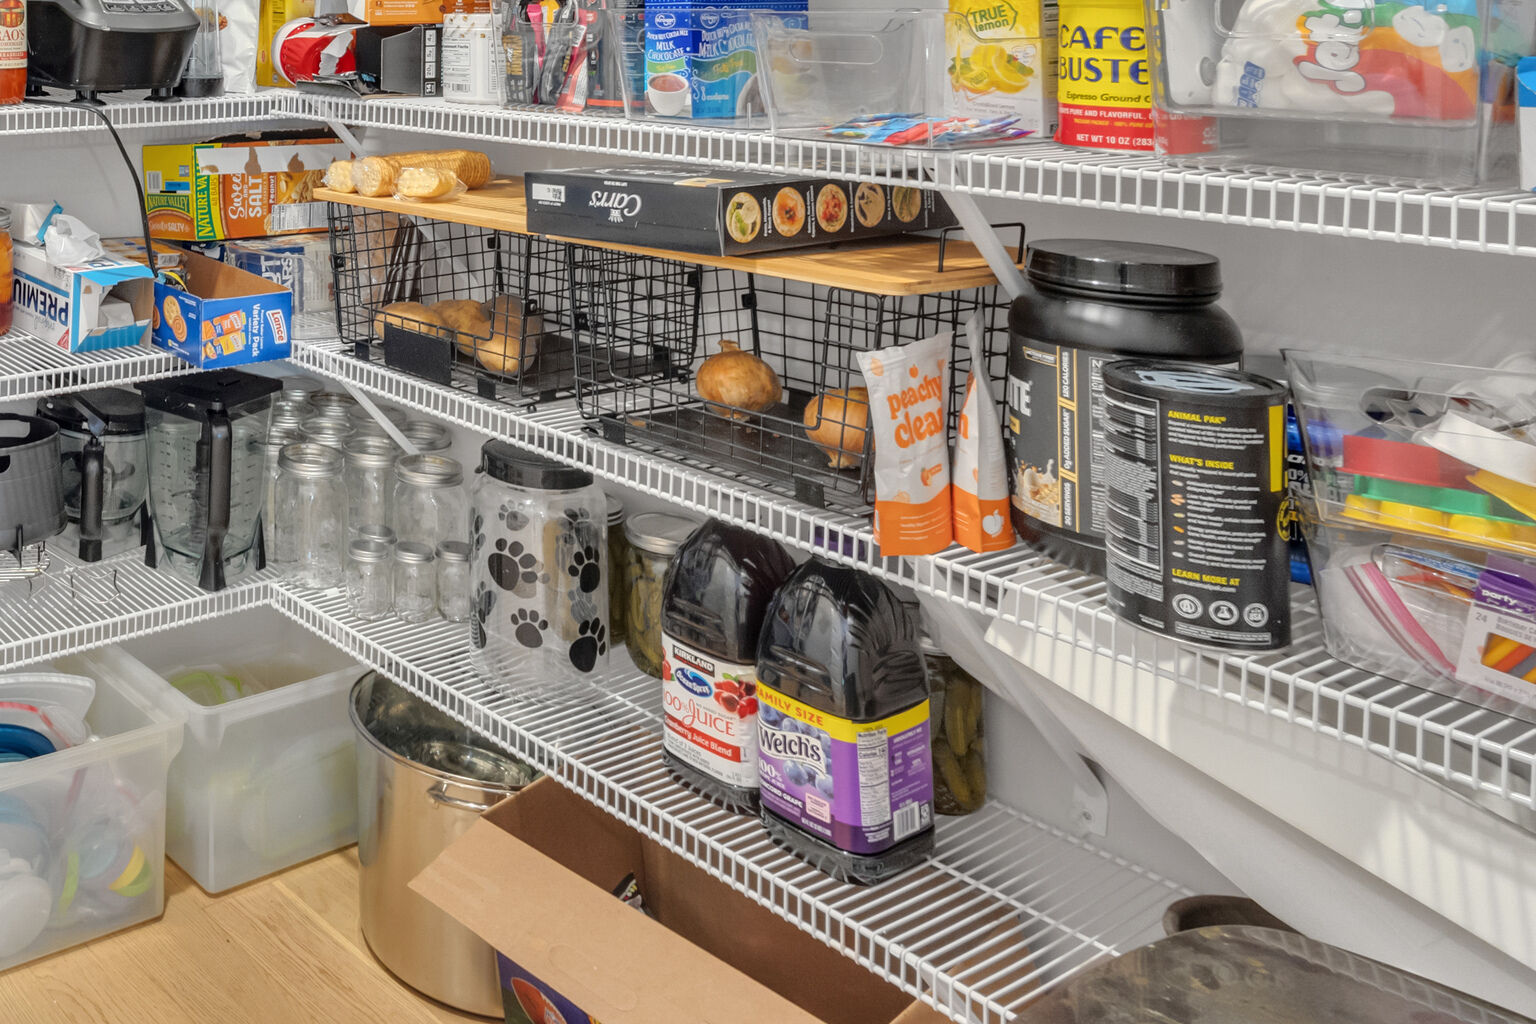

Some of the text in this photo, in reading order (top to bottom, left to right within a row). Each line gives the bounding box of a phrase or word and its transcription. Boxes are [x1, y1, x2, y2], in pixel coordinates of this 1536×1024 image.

[970, 5, 1008, 24] TRUE
[974, 17, 1010, 34] lemon
[656, 40, 676, 52] MILK
[1059, 24, 1147, 52] CAFE
[647, 47, 686, 61] CHOCOLATE
[1060, 57, 1149, 86] BUSTE
[1066, 90, 1140, 104] Espresso Ground
[1101, 110, 1146, 121] FLAVORFUL.
[1076, 134, 1131, 145] NET WT 10 OZ
[268, 175, 276, 205] Peanut
[147, 195, 189, 211] NATURE VALLEY
[589, 187, 643, 218] Carr's
[196, 191, 211, 237] NATURE
[14, 278, 69, 327] PREMIU
[252, 303, 261, 358] Variety Pack
[271, 311, 285, 342] Lance
[1061, 353, 1071, 387] CALORIES
[885, 375, 943, 420] peachy
[1168, 410, 1203, 424] ANIMAL
[1169, 454, 1234, 470] WHAT'S INSIDE
[1172, 568, 1241, 587] LEARN MORE AT
[1481, 589, 1517, 606] party
[1475, 611, 1488, 623] 24
[674, 646, 714, 672] KIRKLAND
[676, 671, 713, 695] Ocean Spray
[794, 706, 824, 727] SIZE
[692, 734, 733, 758] Juice Blend
[759, 726, 823, 763] Welch's
